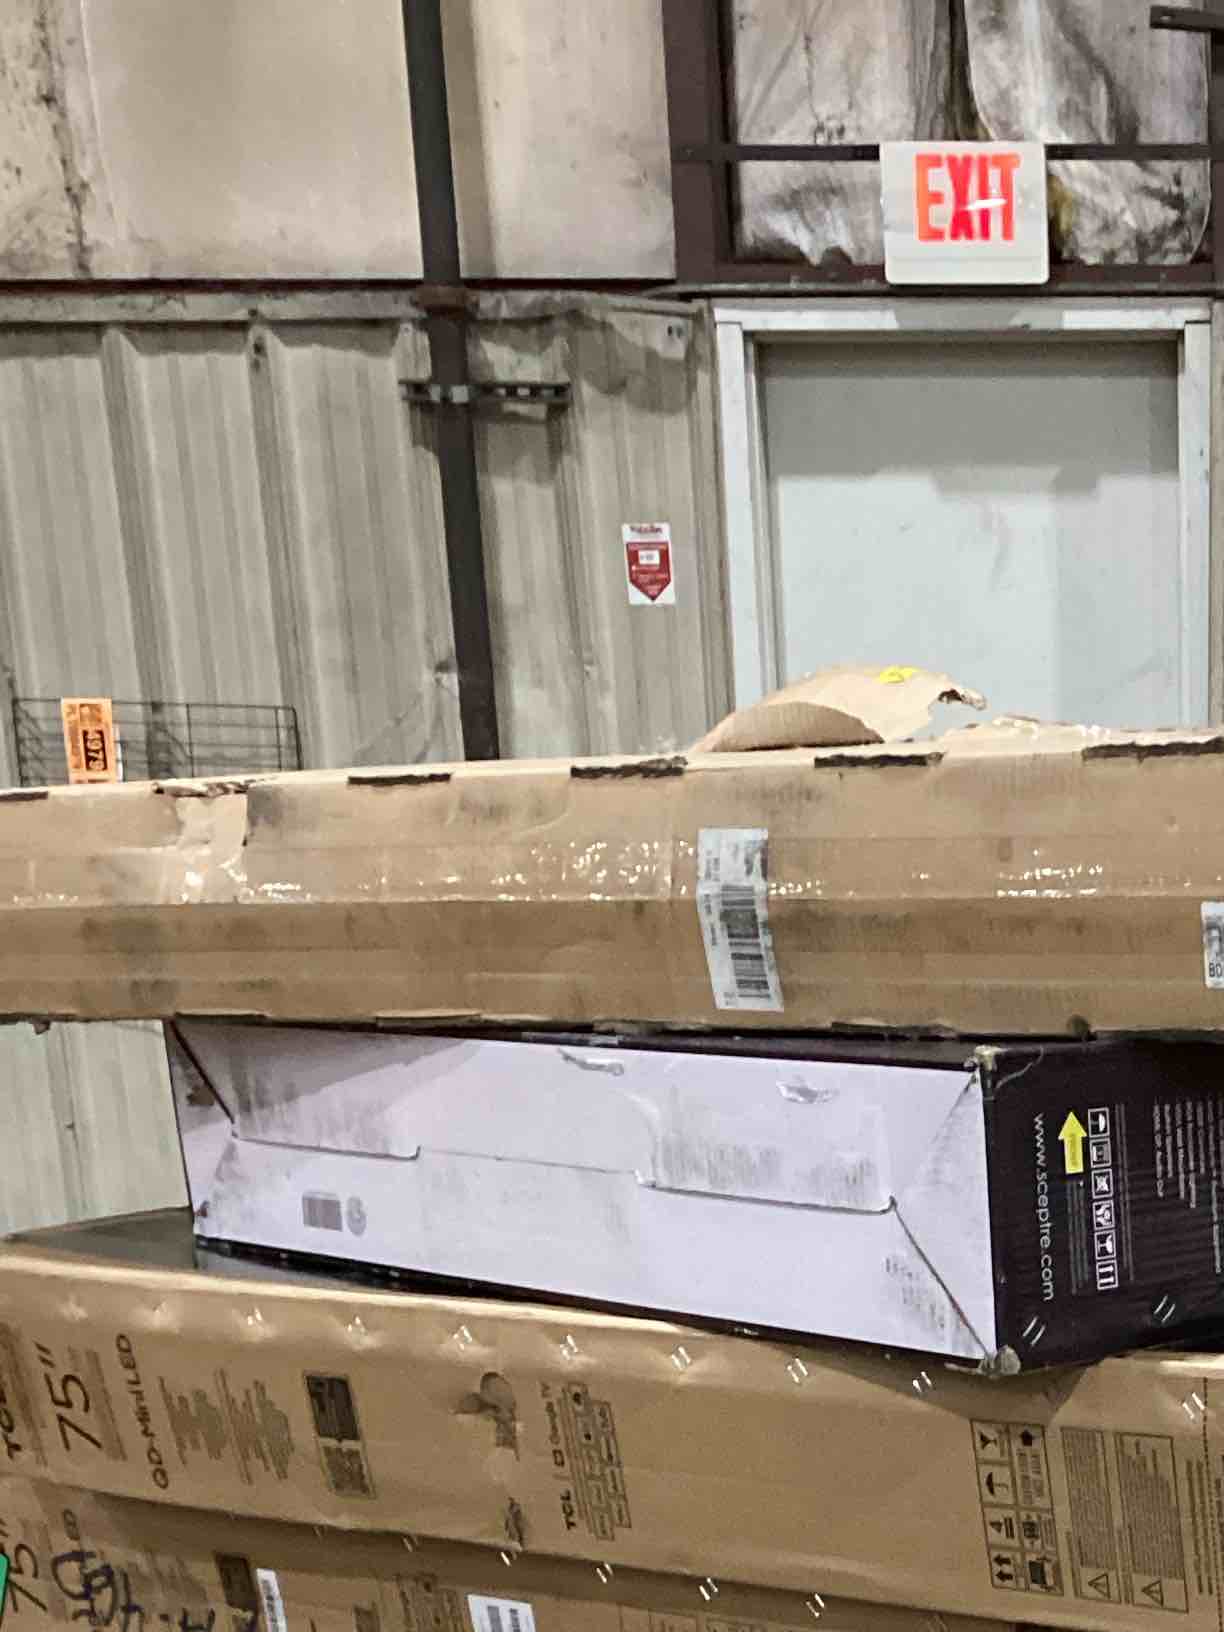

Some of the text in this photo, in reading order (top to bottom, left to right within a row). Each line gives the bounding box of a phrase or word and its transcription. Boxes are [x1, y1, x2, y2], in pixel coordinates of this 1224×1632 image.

[915, 153, 1021, 242] EXIT
[1033, 1113, 1057, 1303] www.sceptre.com
[559, 1489, 577, 1531] TCL
